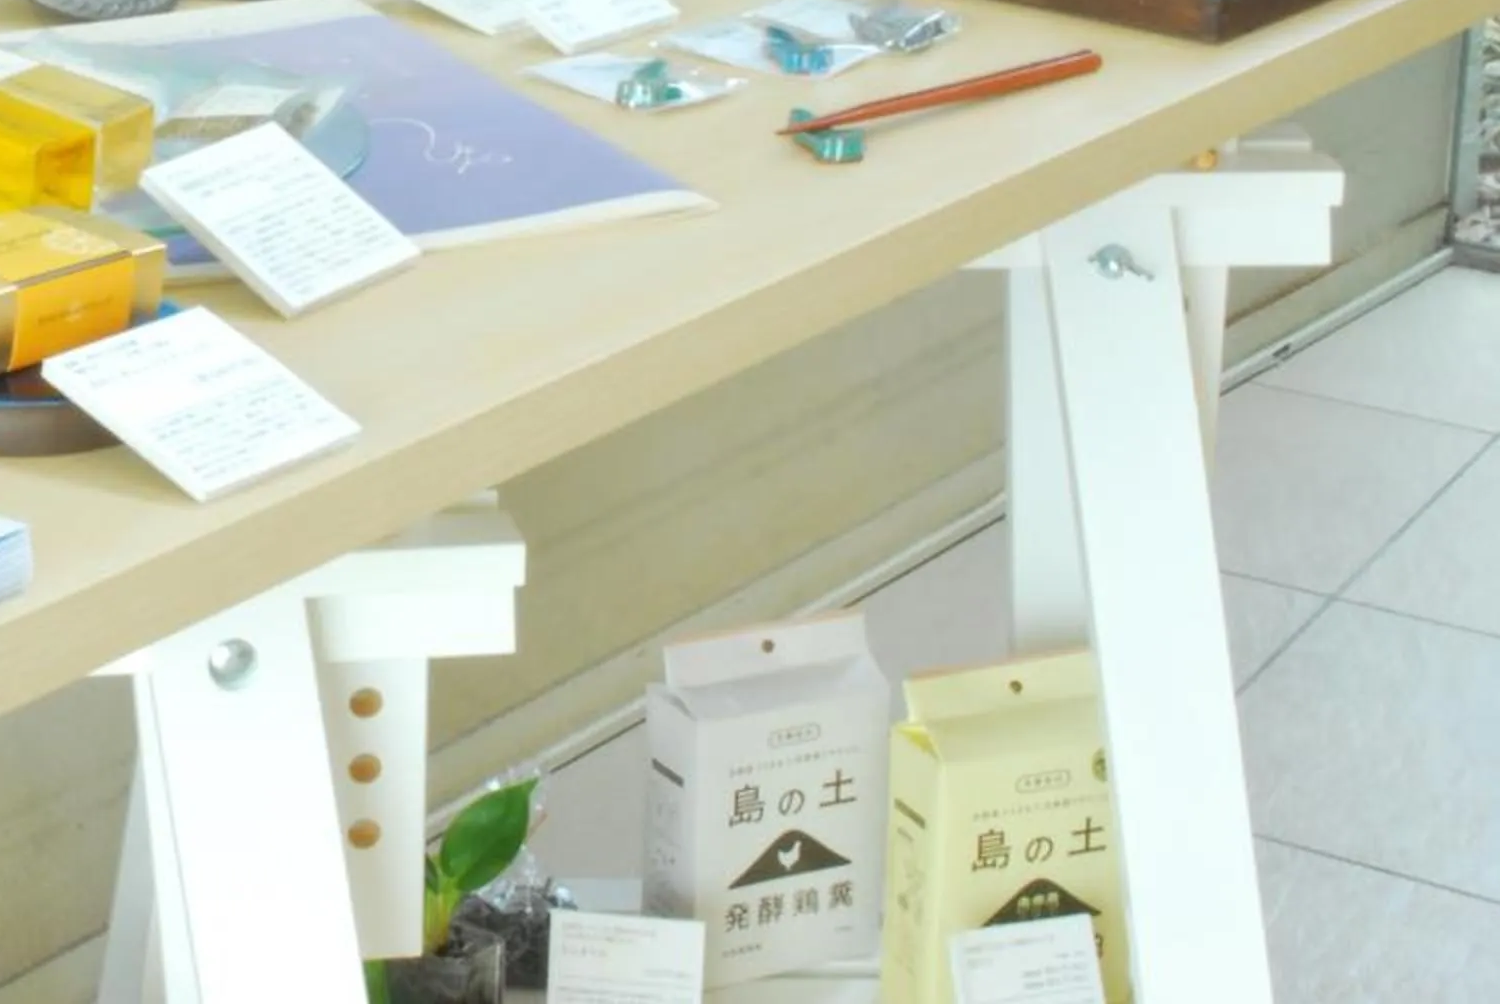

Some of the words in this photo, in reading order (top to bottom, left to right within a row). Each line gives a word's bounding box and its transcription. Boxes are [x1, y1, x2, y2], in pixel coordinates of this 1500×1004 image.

[728, 769, 857, 828] 島の土
[971, 816, 1107, 872] 島の土
